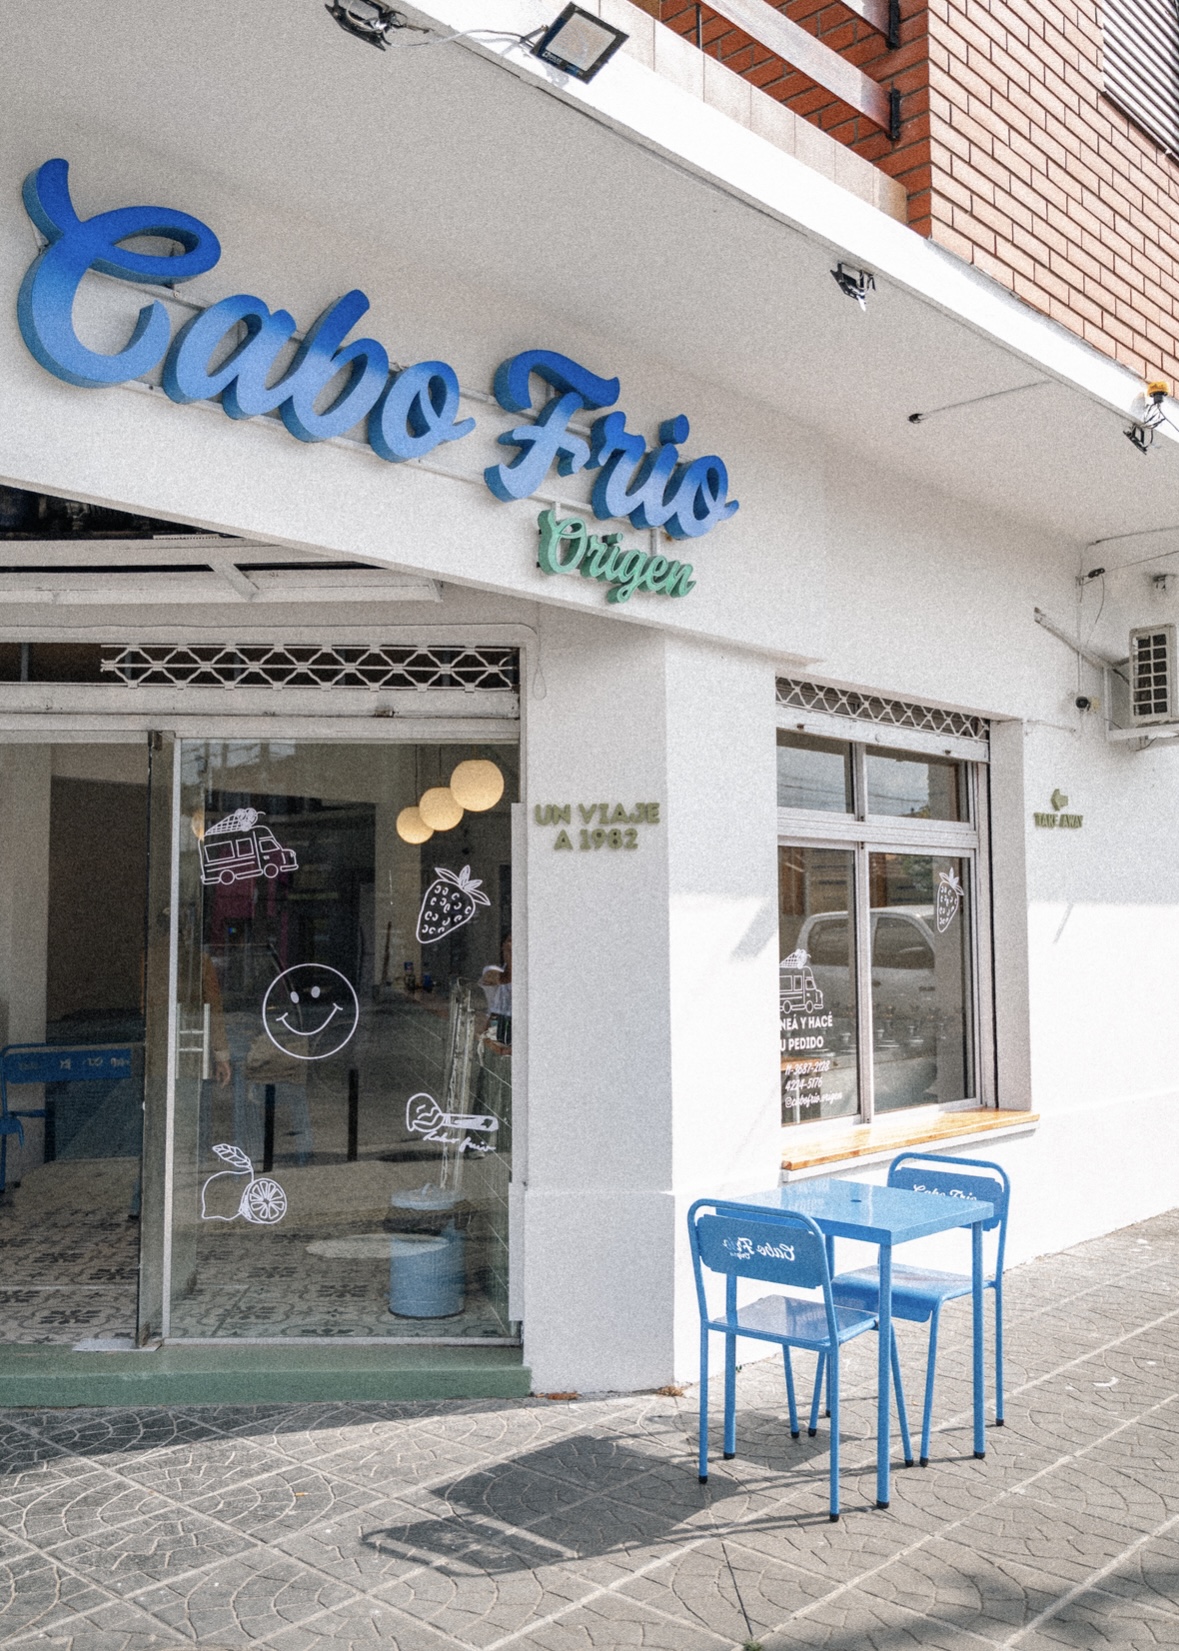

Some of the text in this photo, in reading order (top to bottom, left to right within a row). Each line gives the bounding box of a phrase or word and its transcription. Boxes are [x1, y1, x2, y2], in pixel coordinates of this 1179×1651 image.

[17, 158, 739, 540] Cabo Frio
[537, 509, 696, 604] Origen
[534, 802, 660, 826] UN VIAJE
[1034, 812, 1083, 829] TAKE AWAY
[554, 828, 638, 850] A 1982
[800, 1016, 807, 1029] Y
[808, 1011, 833, 1028] HACÉ
[788, 1036, 824, 1050] PEDIDO
